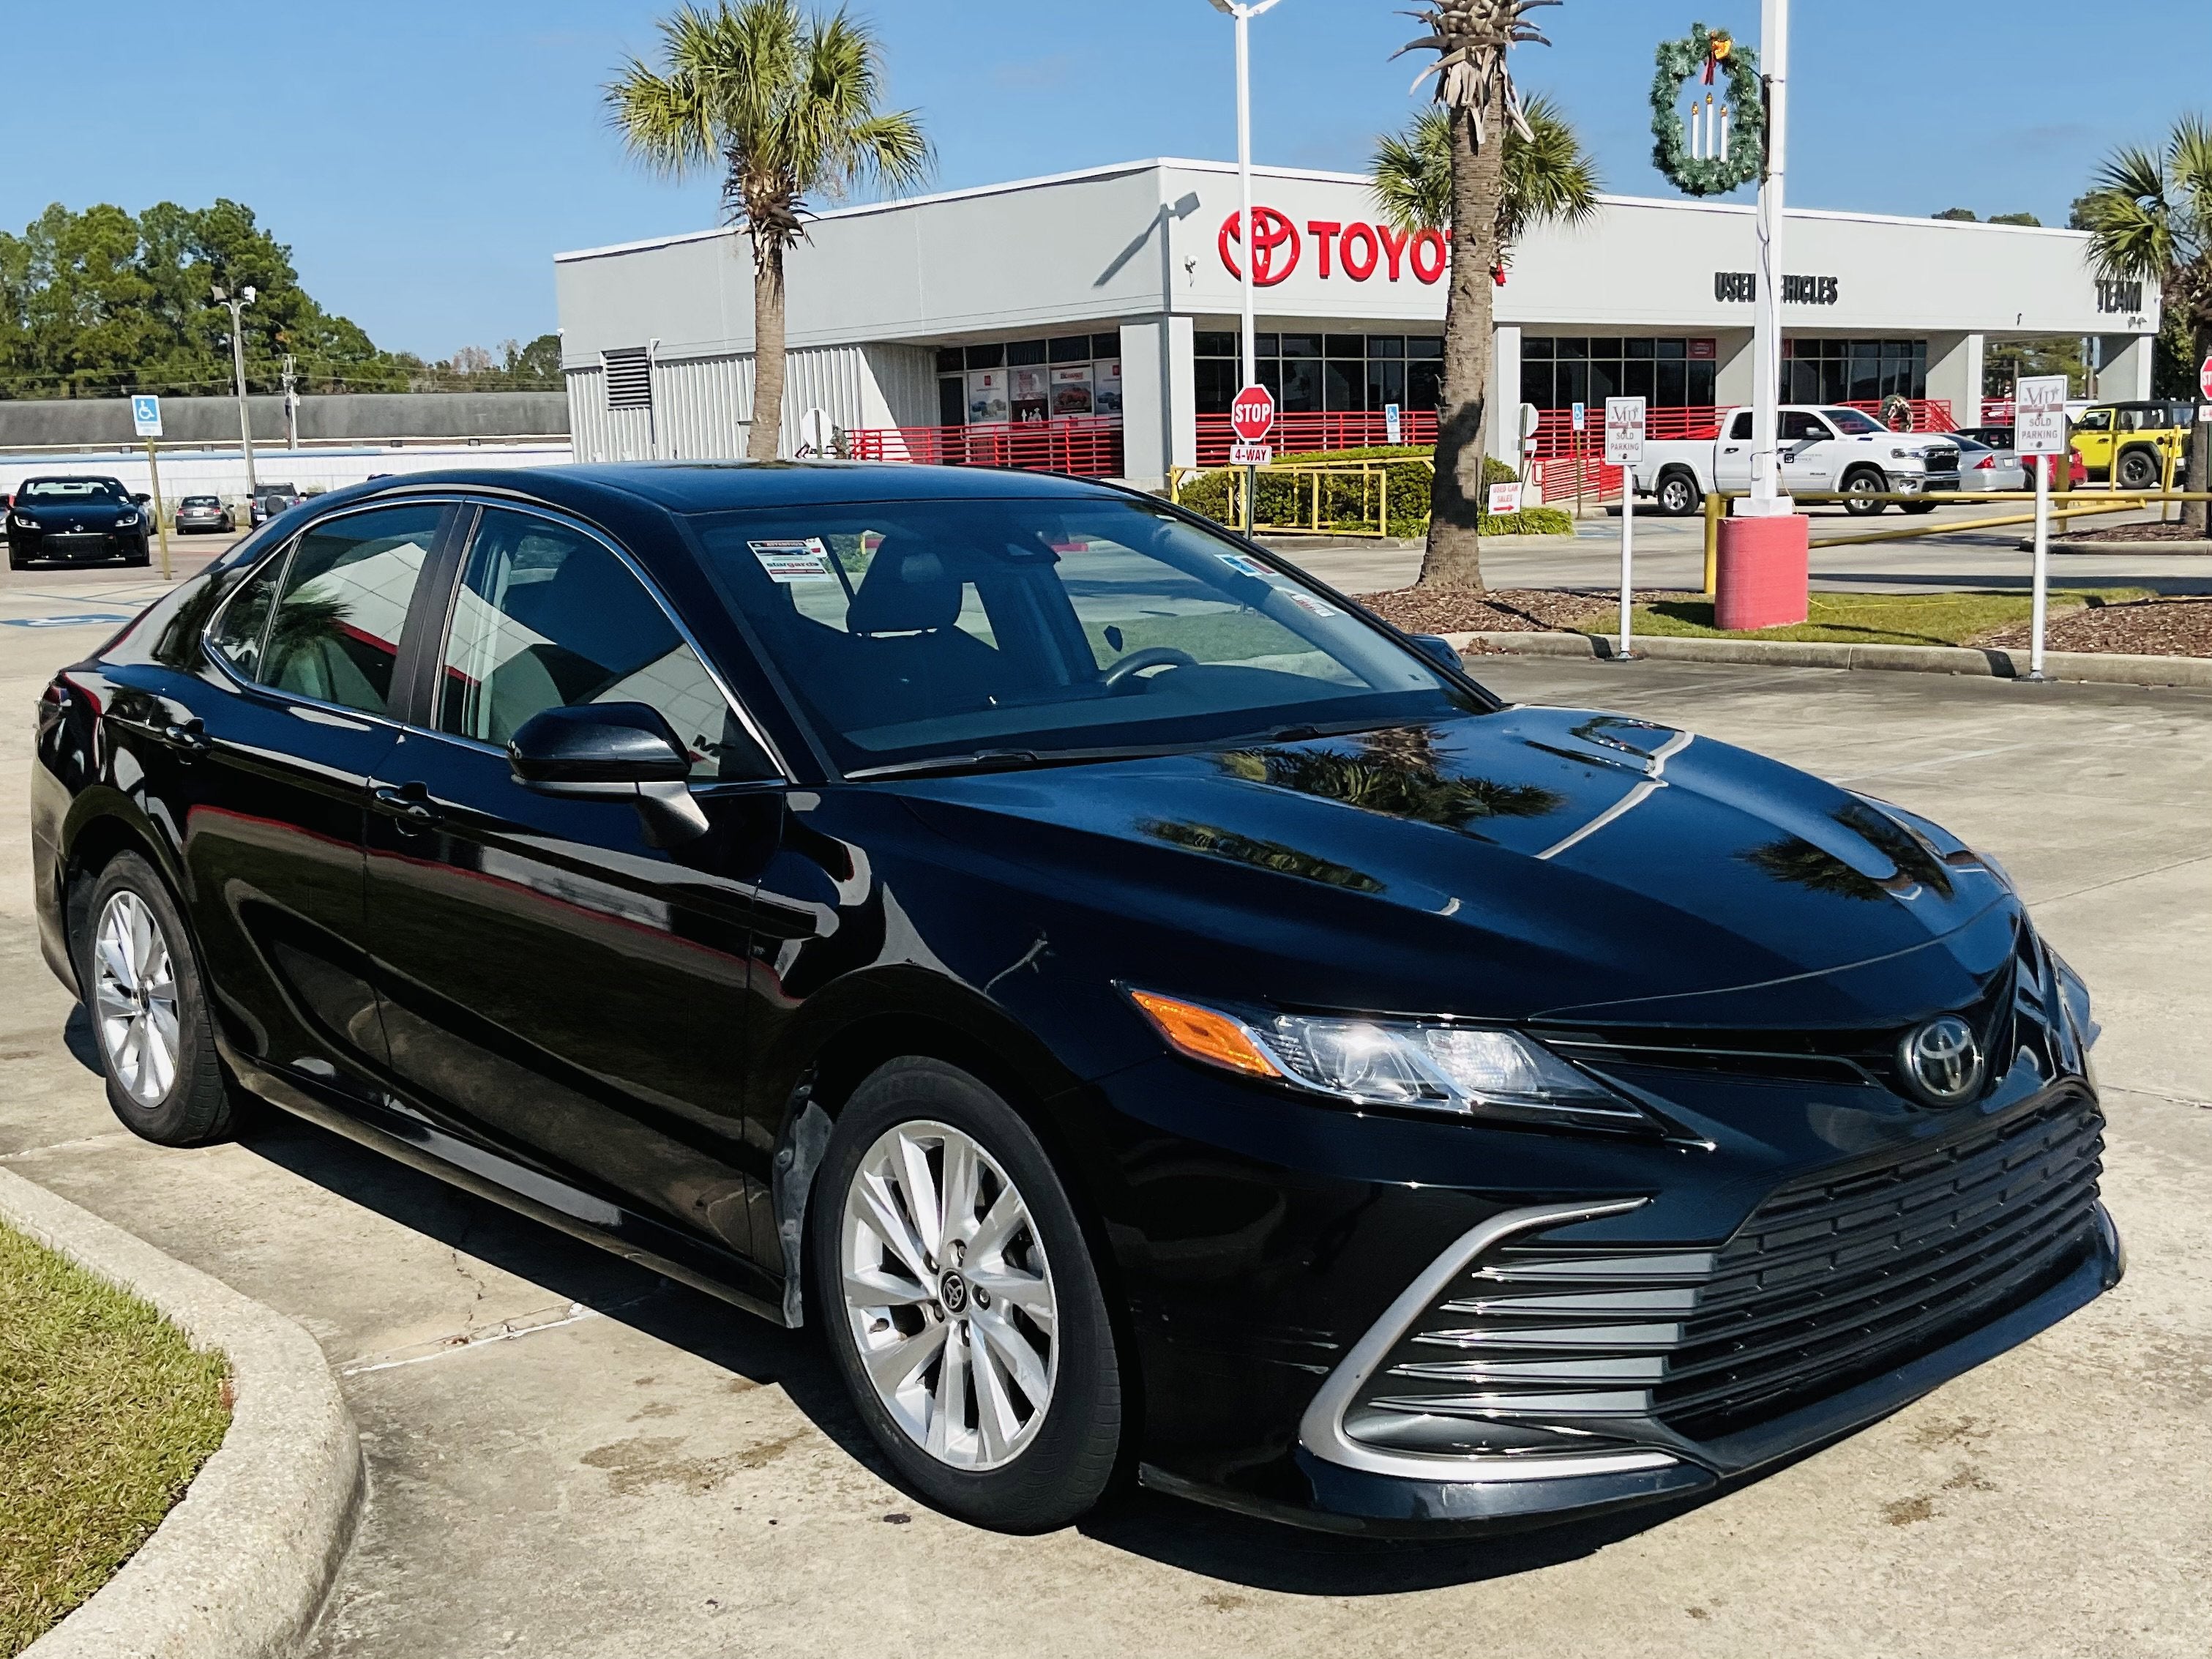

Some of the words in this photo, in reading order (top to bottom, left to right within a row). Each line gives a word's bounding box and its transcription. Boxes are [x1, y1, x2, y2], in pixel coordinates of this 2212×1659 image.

[1307, 220, 1506, 286] TOYO
[2095, 280, 2142, 314] TEAM
[1235, 403, 1271, 423] STOP
[2028, 418, 2052, 427] SOLD
[1616, 432, 1634, 440] SOLD
[2021, 430, 2058, 440] PARKING
[1610, 443, 1640, 451] PARKING
[1235, 448, 1267, 461] 4-WAY
[1492, 485, 1506, 493] USED
[1497, 494, 1512, 503] SALES
